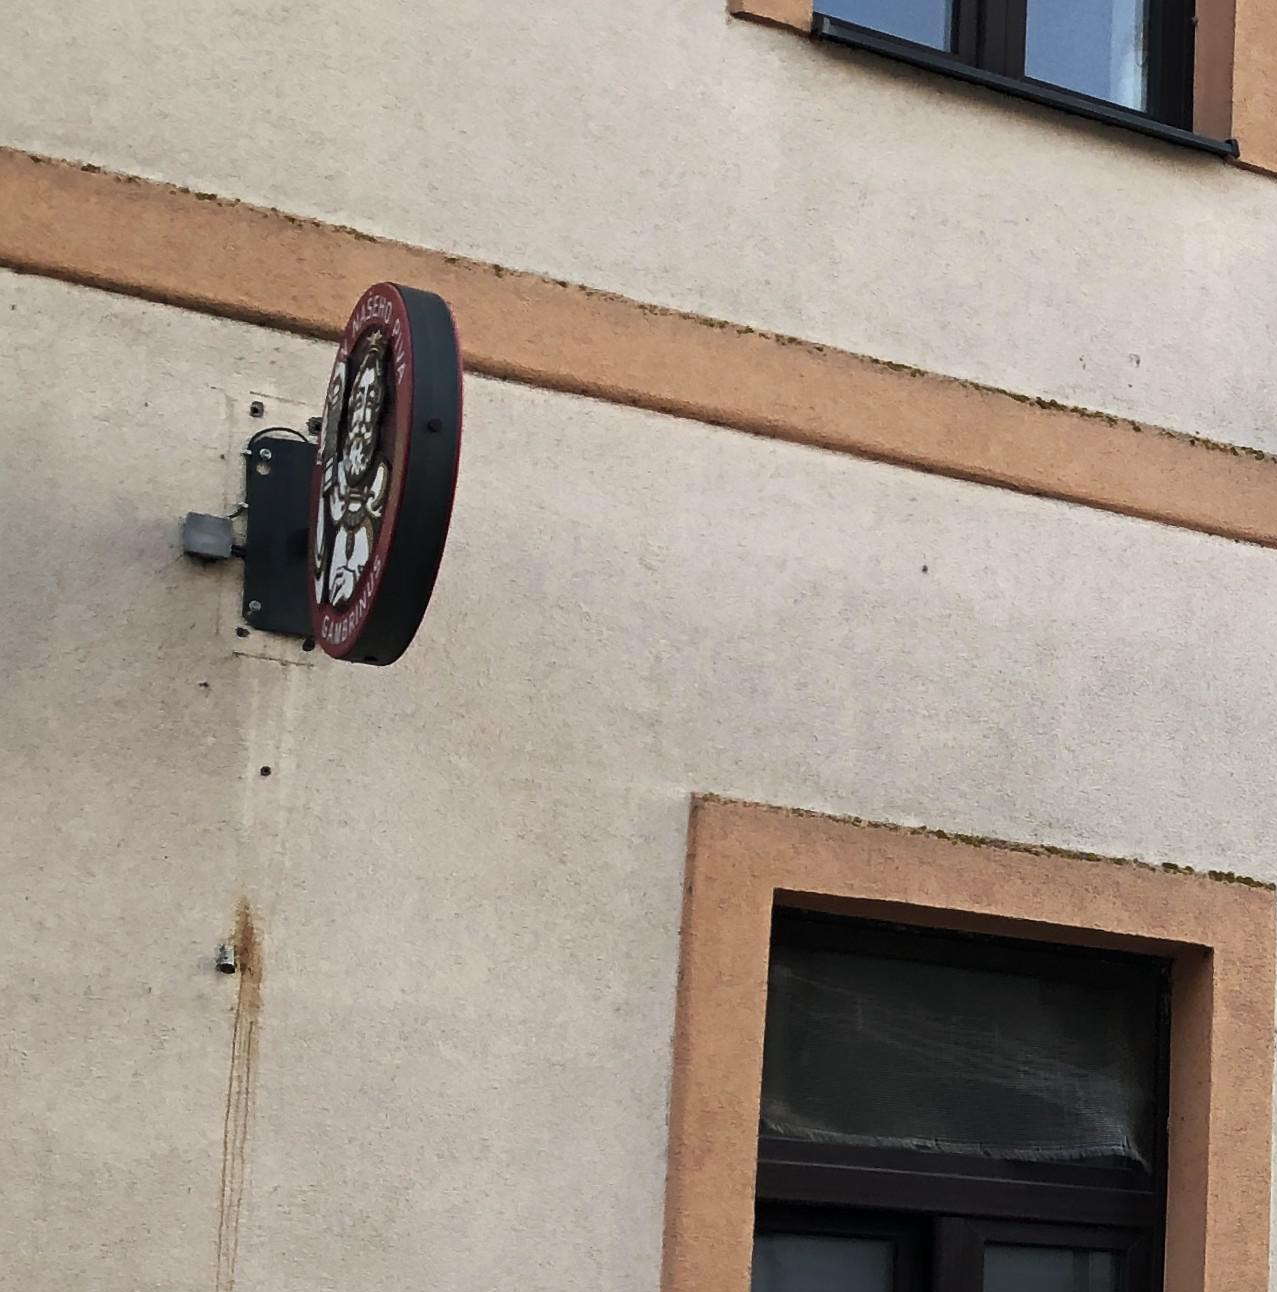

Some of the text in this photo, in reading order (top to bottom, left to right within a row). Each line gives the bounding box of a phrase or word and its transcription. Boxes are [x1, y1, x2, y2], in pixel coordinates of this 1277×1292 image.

[352, 291, 406, 385] NAŠEHO PIVA
[321, 555, 381, 645] GAMBRINUS
